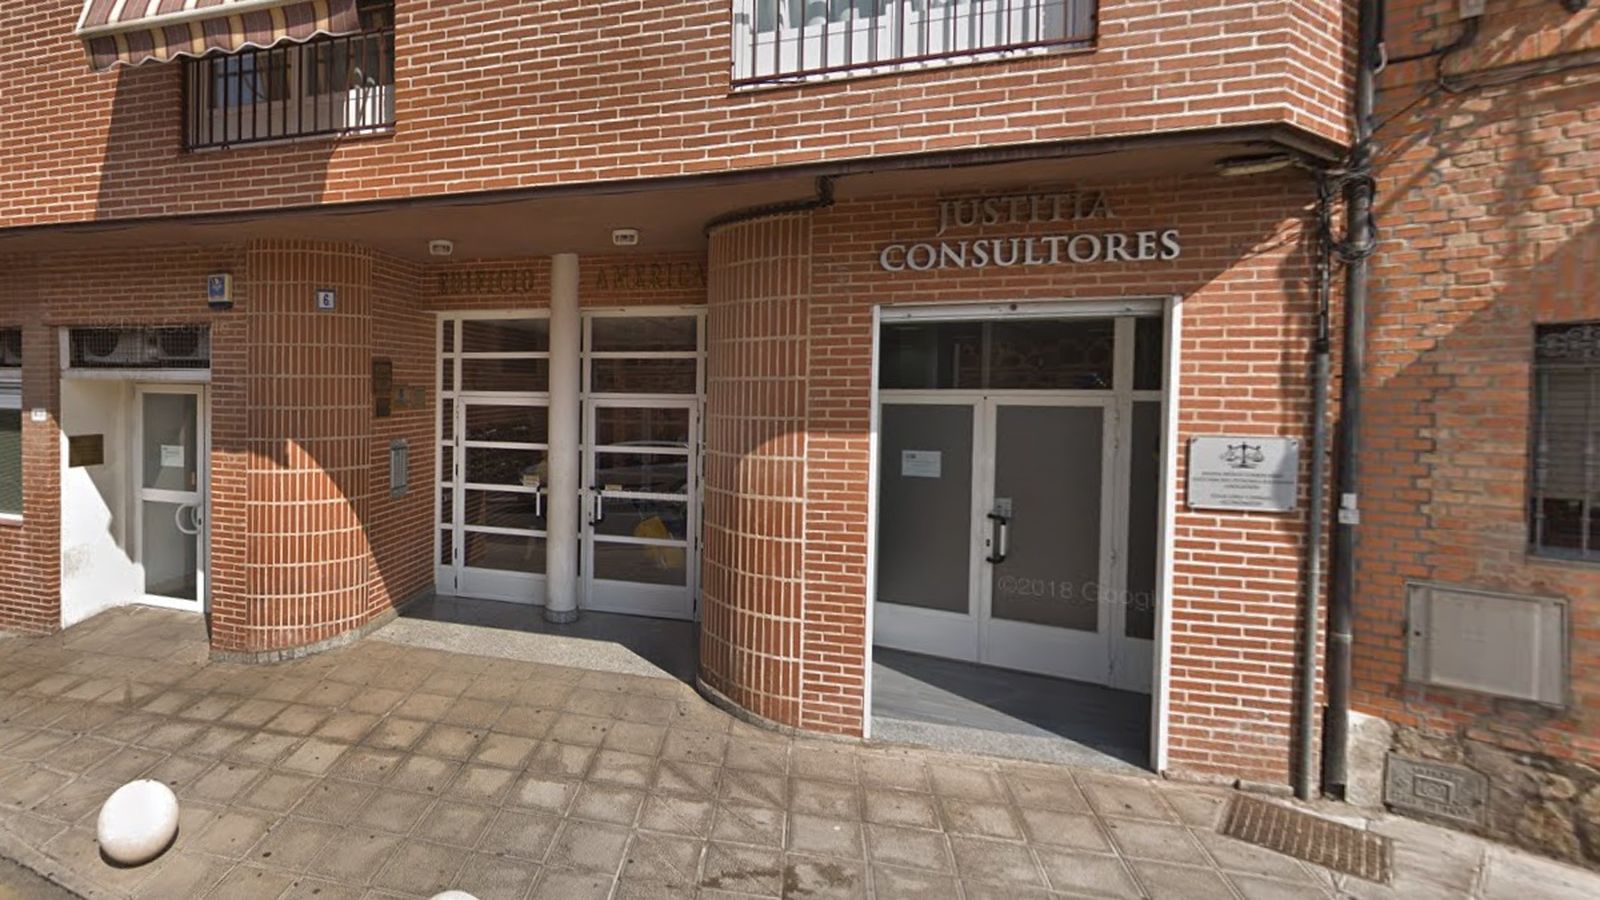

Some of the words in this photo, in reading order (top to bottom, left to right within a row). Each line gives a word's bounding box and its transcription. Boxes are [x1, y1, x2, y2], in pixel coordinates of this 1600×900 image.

[937, 193, 1116, 237] JUSTITIA
[880, 229, 1180, 272] CONSULTORES
[322, 293, 330, 306] 6
